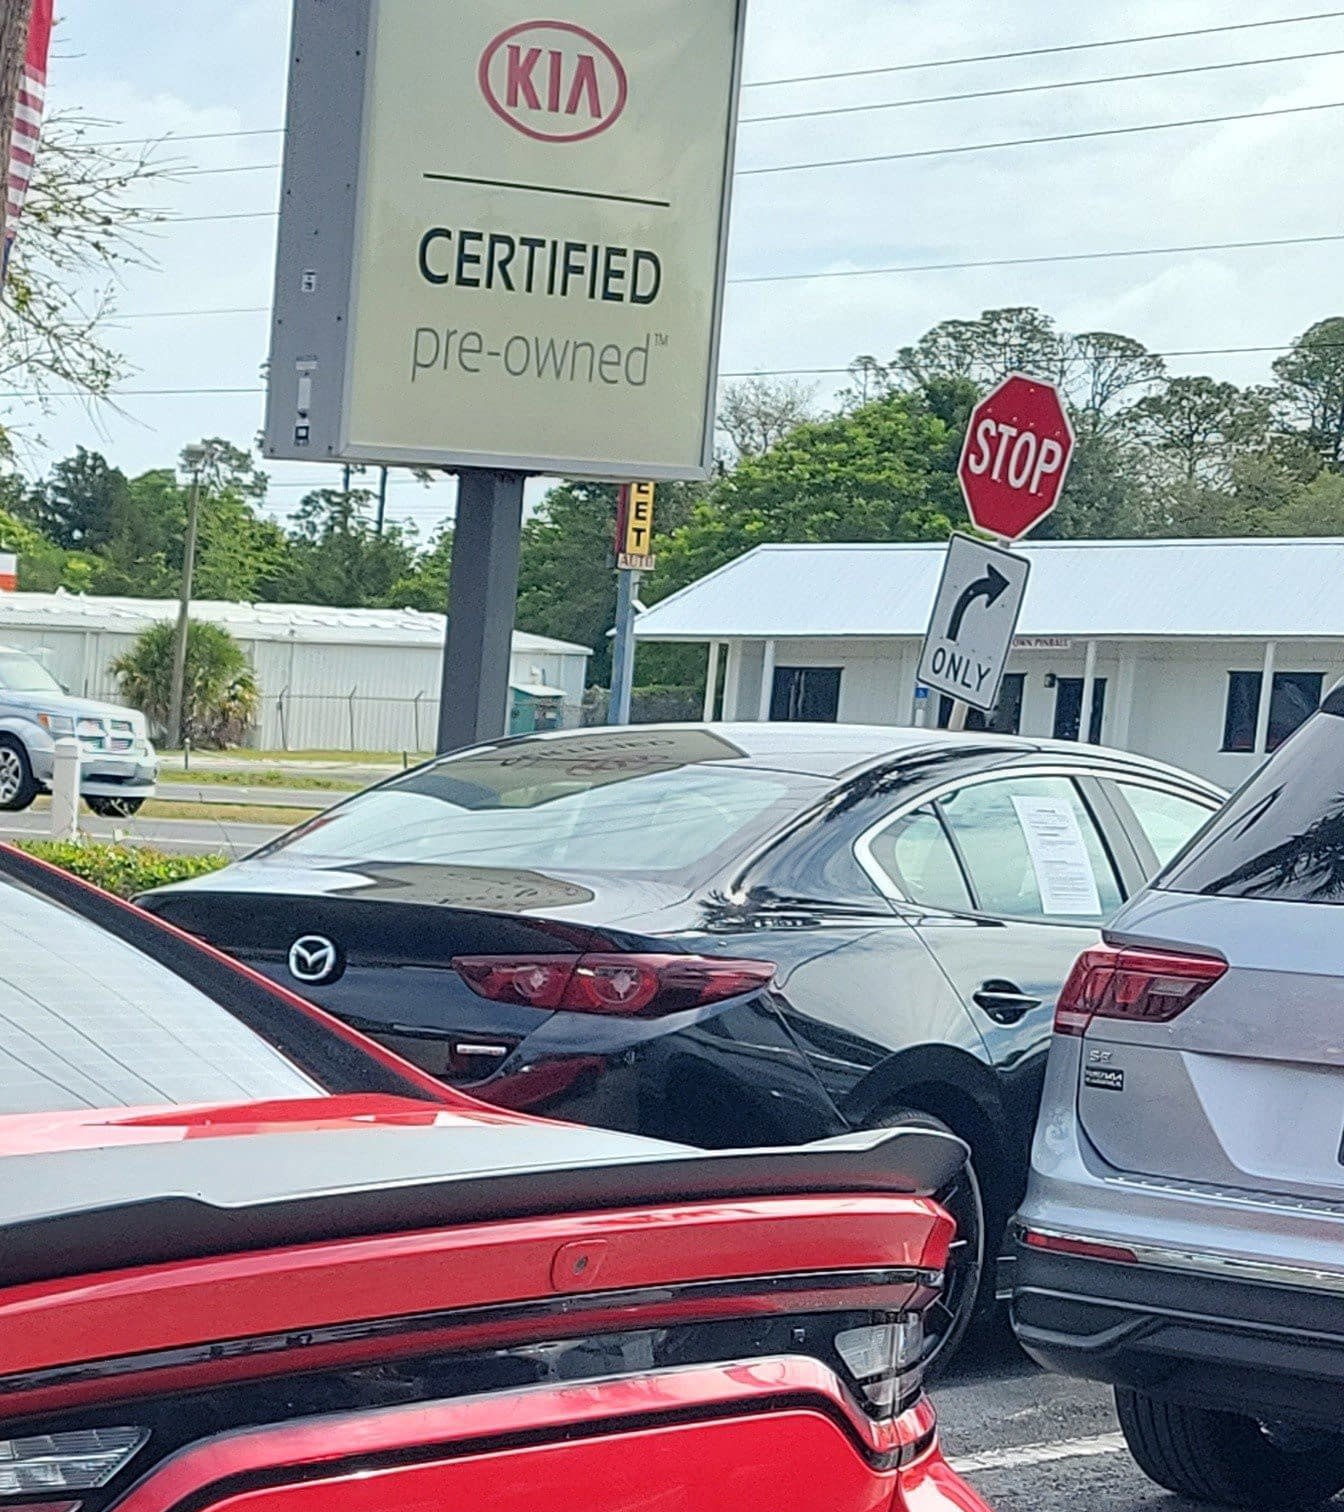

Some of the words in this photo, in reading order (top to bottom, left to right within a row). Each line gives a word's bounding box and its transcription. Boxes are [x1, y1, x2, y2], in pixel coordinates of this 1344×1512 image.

[506, 44, 602, 118] KIA
[418, 228, 661, 305] CERTIFIED
[969, 419, 1063, 496] STOP
[932, 648, 991, 692] ONLY
